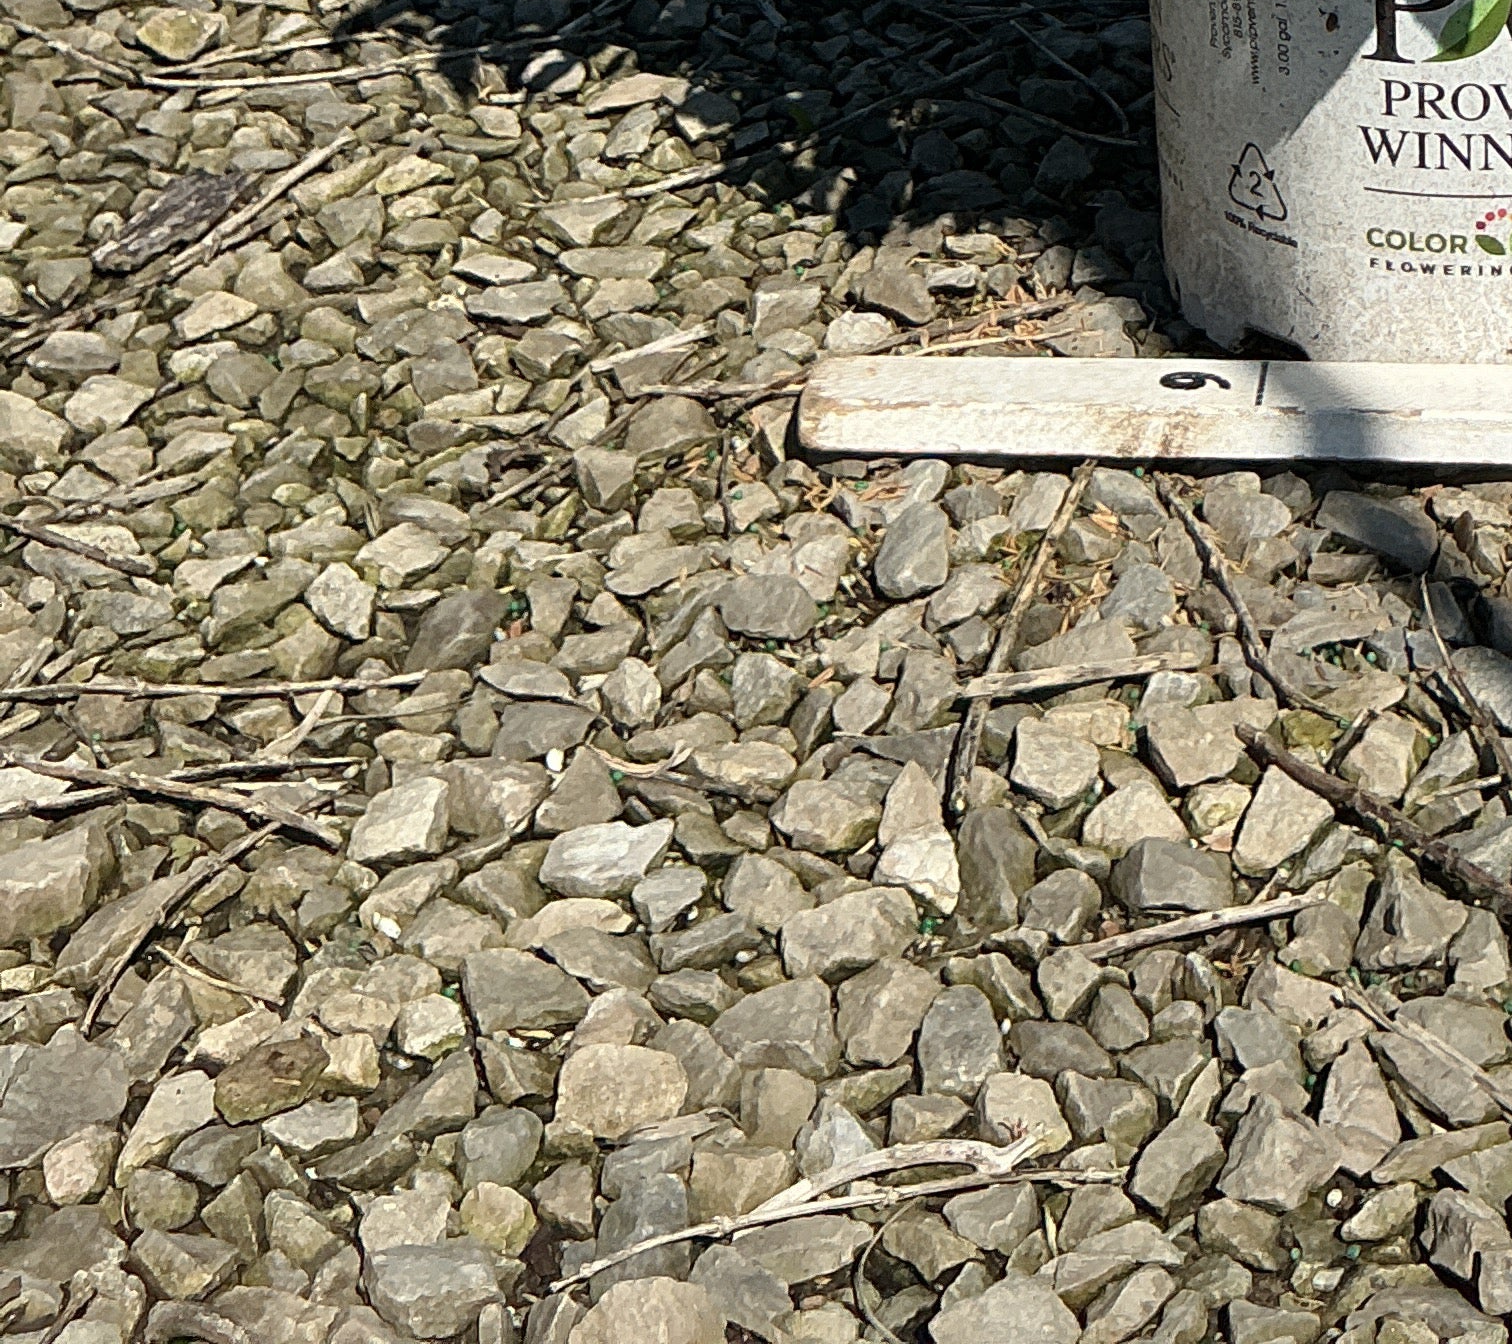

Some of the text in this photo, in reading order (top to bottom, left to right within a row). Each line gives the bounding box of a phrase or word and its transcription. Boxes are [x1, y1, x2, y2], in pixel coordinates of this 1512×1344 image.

[1276, 17, 1292, 42] gal
[1277, 43, 1290, 77] 3.00
[1366, 227, 1469, 255] COLOR
[1159, 371, 1232, 390] 6
